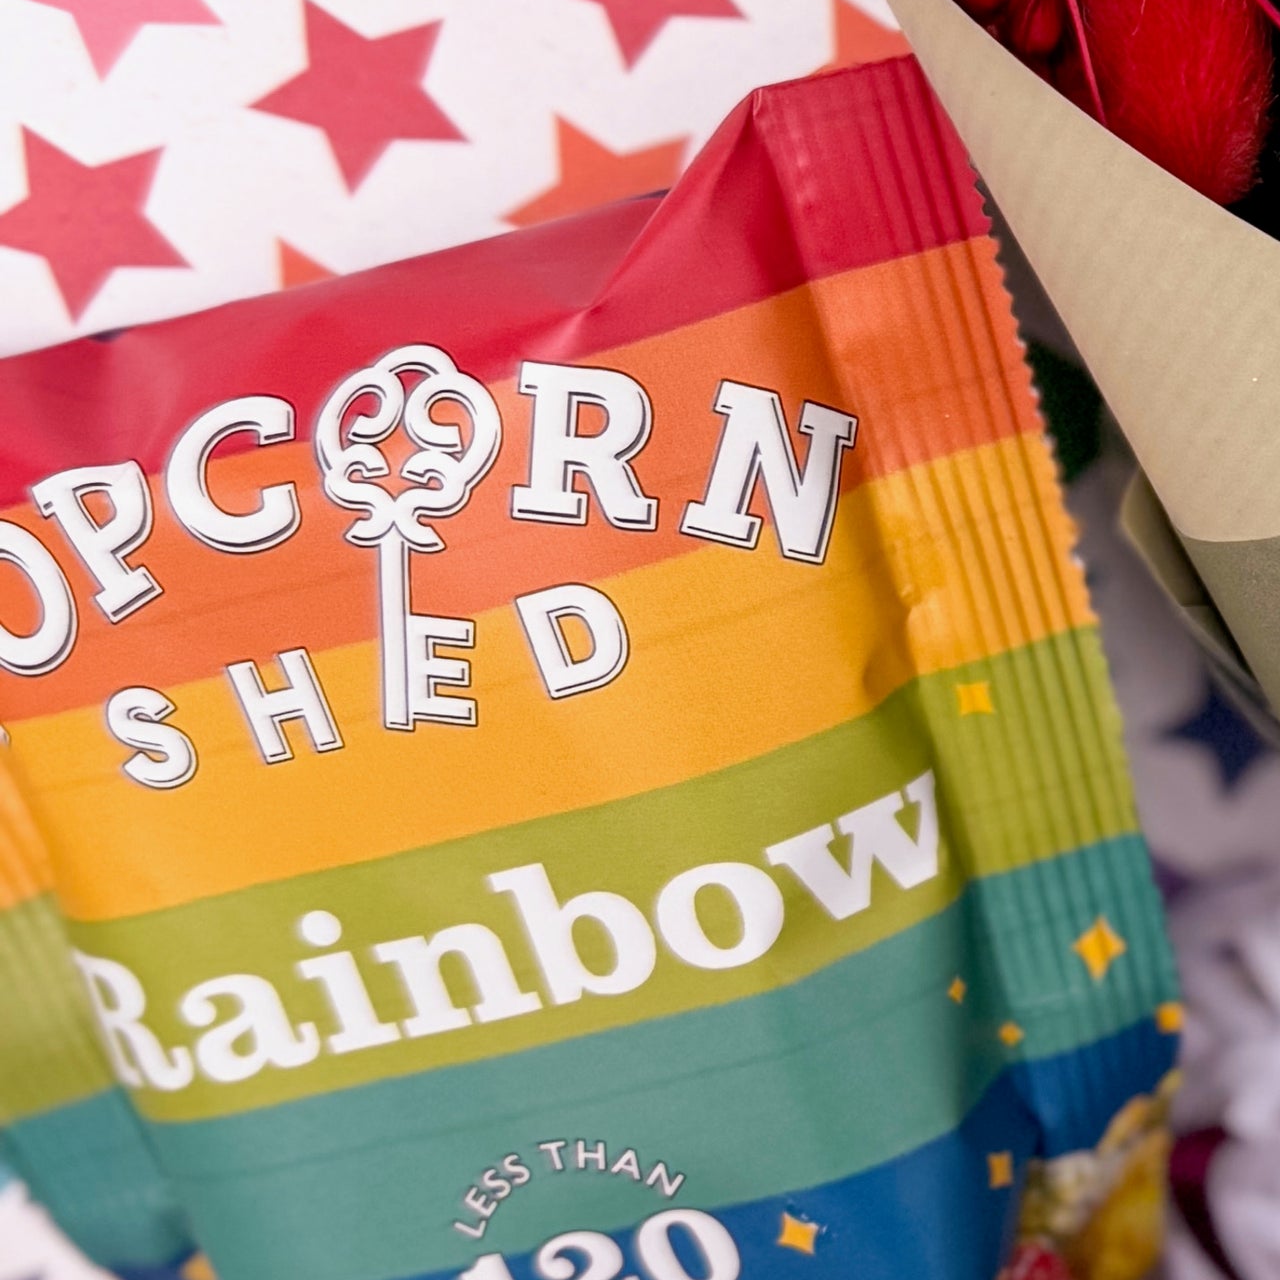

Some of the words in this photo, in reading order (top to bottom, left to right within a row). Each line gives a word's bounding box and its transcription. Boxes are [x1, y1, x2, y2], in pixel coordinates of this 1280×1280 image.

[104, 583, 628, 788] SHED
[74, 770, 940, 1093] Rainbow
[454, 1153, 532, 1240] LESS
[540, 1139, 686, 1197] THAN
